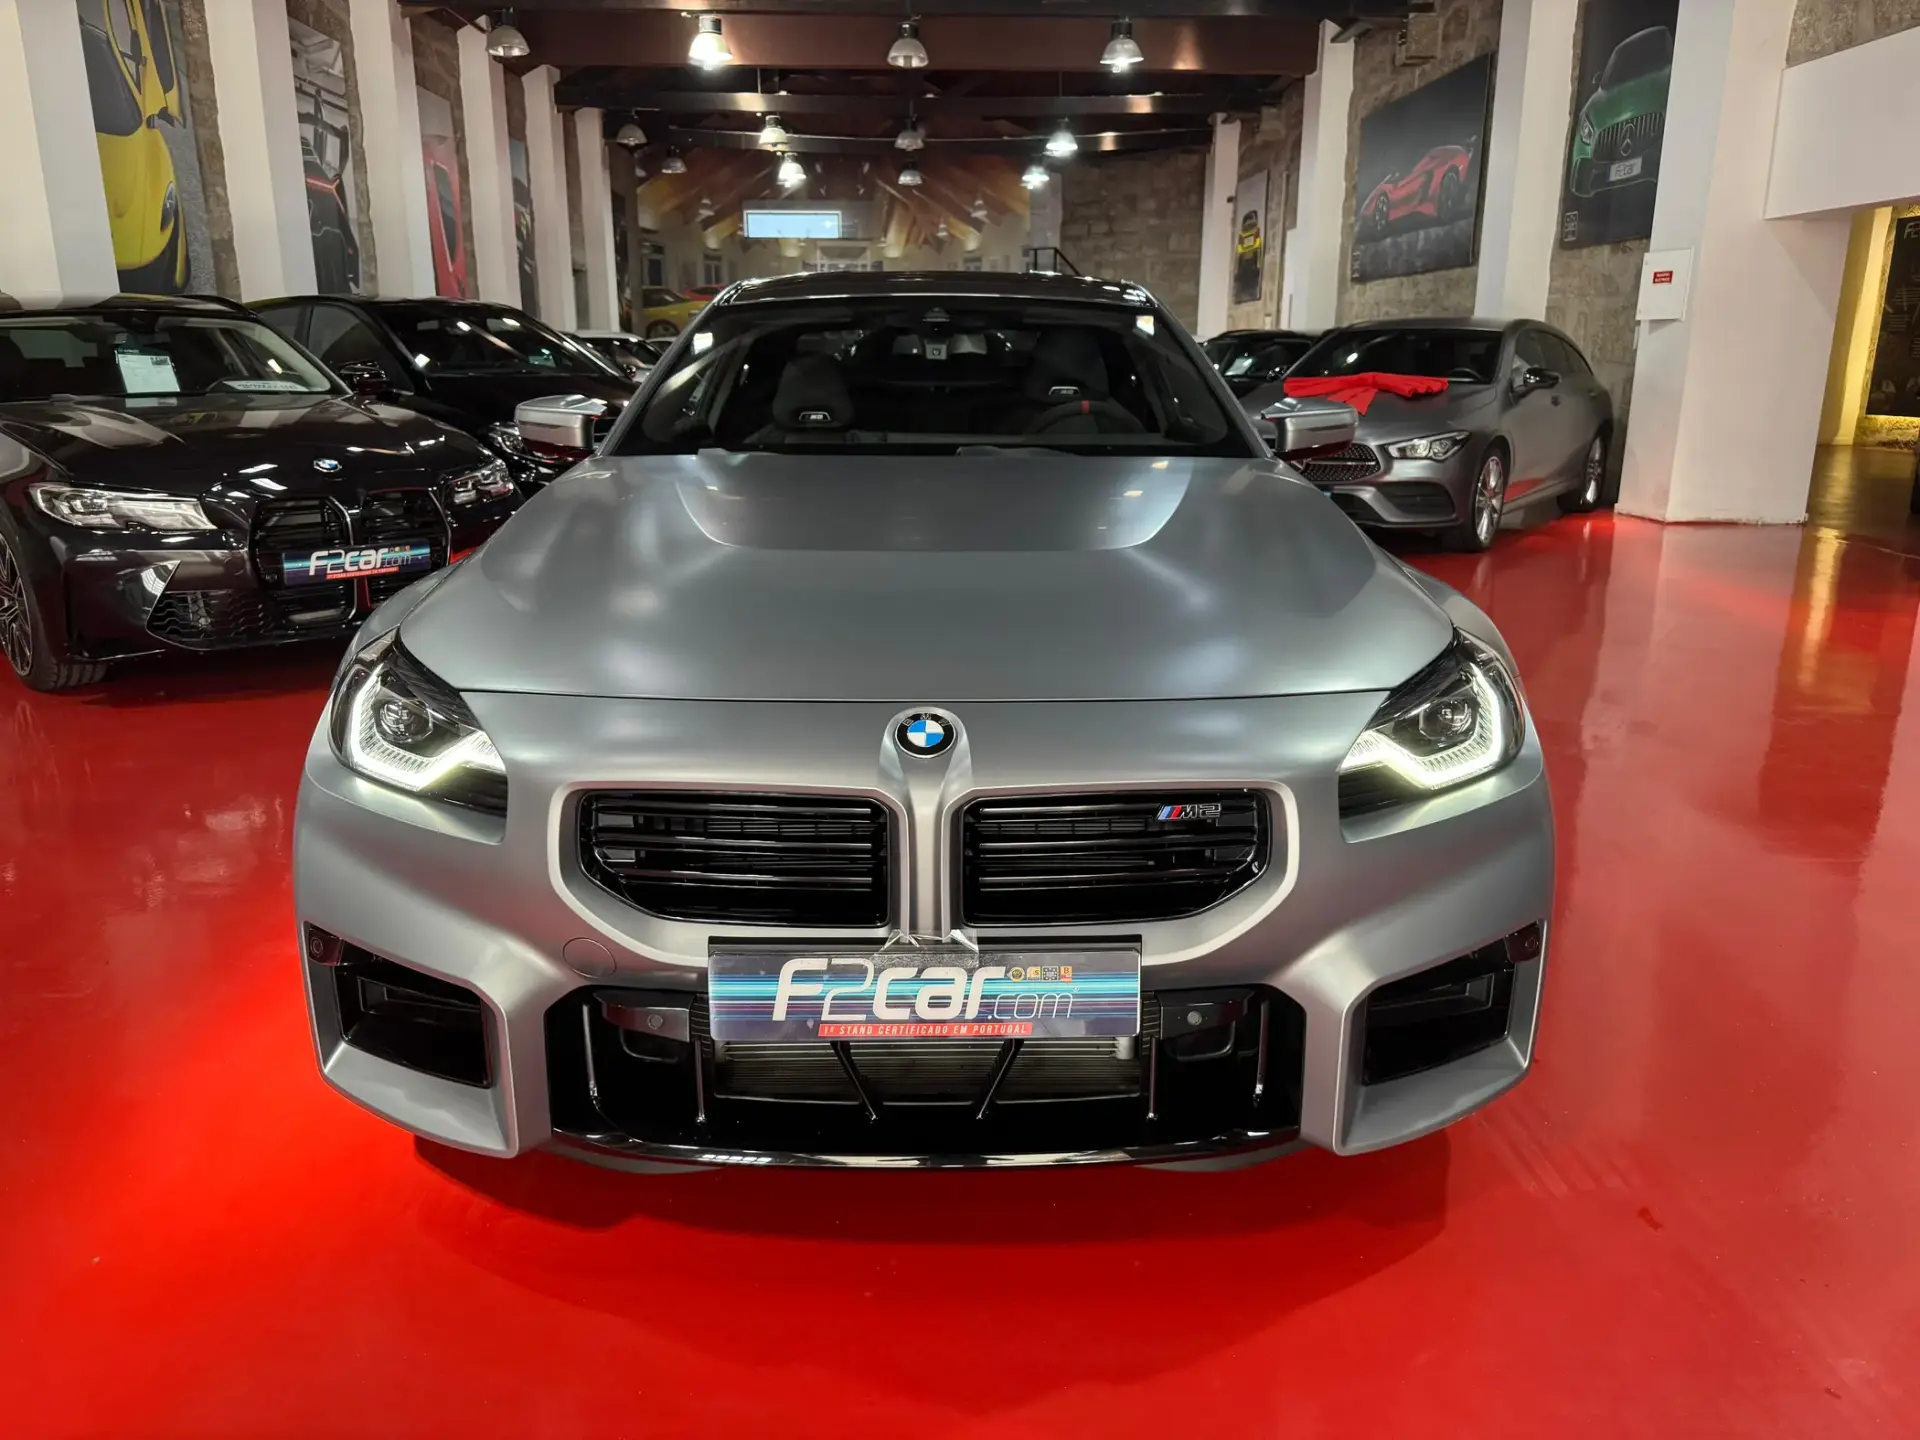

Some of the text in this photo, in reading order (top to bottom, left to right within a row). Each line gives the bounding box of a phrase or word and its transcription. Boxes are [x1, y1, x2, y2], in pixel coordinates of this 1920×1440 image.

[1179, 803, 1222, 819] M2
[839, 1025, 873, 1035] STAND
[878, 1025, 948, 1035] CERTIFICADO
[953, 1025, 968, 1034] EM
[973, 1024, 1027, 1034] PORTUGAL
